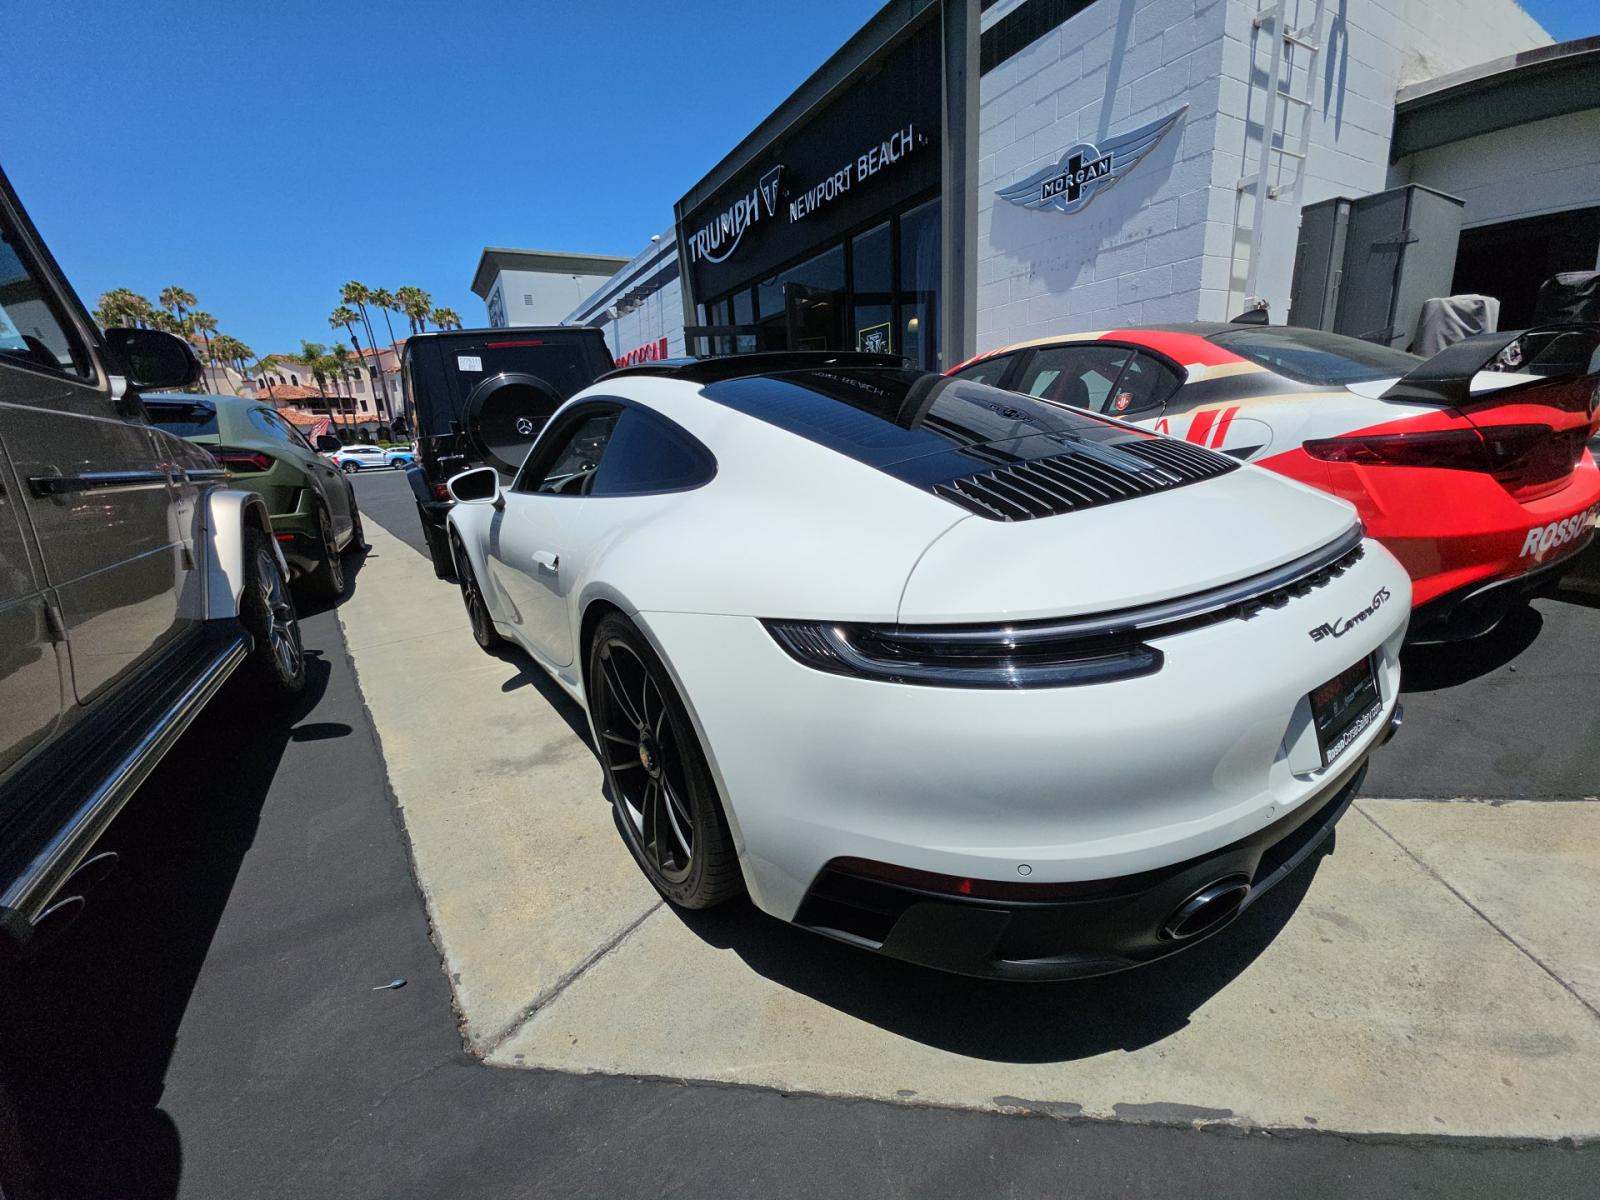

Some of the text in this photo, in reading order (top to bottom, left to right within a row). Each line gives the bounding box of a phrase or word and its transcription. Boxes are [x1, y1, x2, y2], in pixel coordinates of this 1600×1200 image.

[789, 123, 913, 224] NEWPORT BEACH
[1044, 158, 1109, 198] MORGAN
[688, 188, 760, 263] TRIUMPH
[1519, 511, 1587, 557] ROSSO
[1372, 586, 1391, 610] GTS
